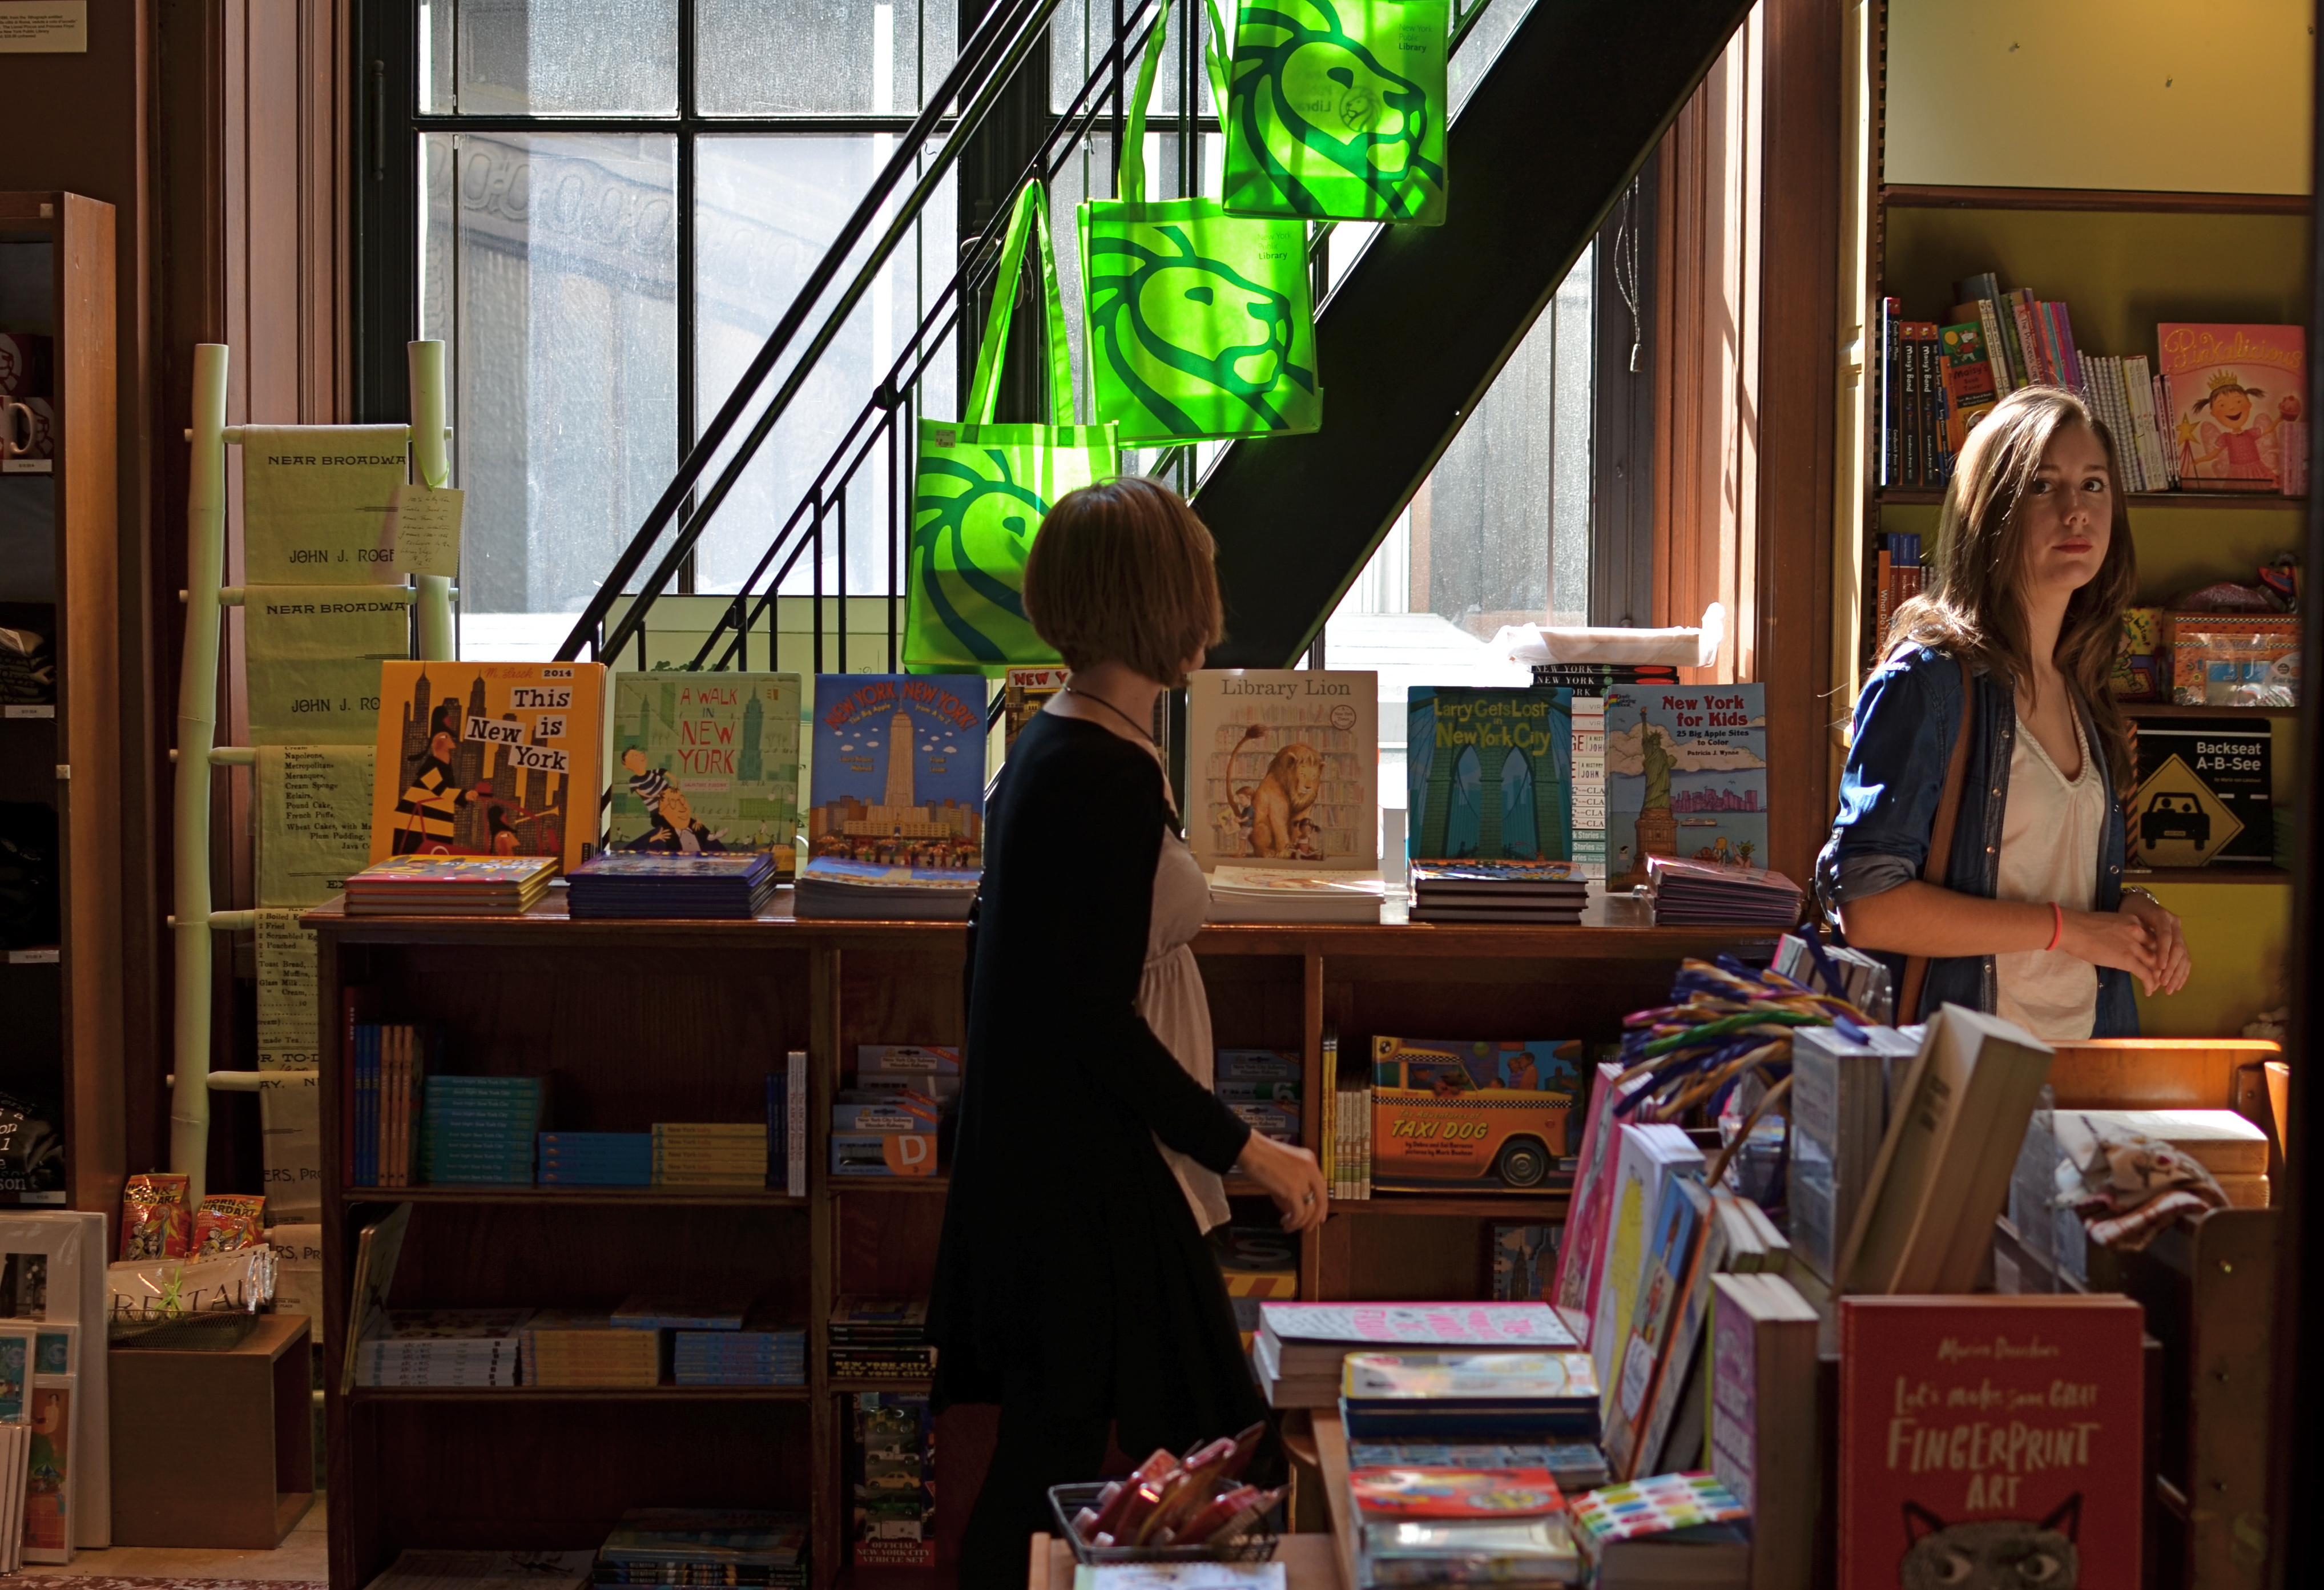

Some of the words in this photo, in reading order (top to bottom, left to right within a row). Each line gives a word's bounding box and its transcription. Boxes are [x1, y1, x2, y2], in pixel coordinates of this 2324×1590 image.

[1399, 43, 1427, 53] Library
[2024, 332, 2036, 363] Princess
[2165, 328, 2302, 369] Pinkalicious
[1905, 345, 1914, 373] Maisy's
[1954, 364, 1988, 379] Maisy's
[268, 456, 316, 465] NEAR
[322, 456, 406, 465] BROADWA
[289, 550, 328, 563] JOHN
[337, 550, 348, 562] J.
[267, 605, 315, 614] NEAR
[321, 602, 409, 614] BROADWA
[1880, 616, 1887, 625] Do
[485, 667, 501, 678] M.
[1536, 665, 1560, 673] NEW
[1564, 665, 1594, 673] YORK
[1014, 671, 1049, 686] NEW
[1537, 676, 1560, 685] NEW
[1565, 676, 1594, 685] YORK
[680, 688, 691, 705] A
[696, 688, 738, 705] WALK
[1222, 679, 1299, 700] Library
[1305, 679, 1351, 695] Lion
[292, 698, 331, 713] JOHN
[340, 698, 351, 711] J.
[514, 689, 570, 707] This
[1662, 695, 1698, 710] New
[1703, 694, 1745, 710] York
[703, 708, 715, 718] IN
[823, 695, 857, 731] NEW
[903, 681, 939, 705] NEW
[936, 689, 980, 732] YORK!
[849, 715, 861, 725] The
[861, 710, 873, 718] Big
[873, 703, 891, 713] Apple
[915, 703, 931, 714] from
[1433, 698, 1473, 722] Larry
[1474, 699, 1511, 718] Gets
[1511, 699, 1549, 718] Lost
[541, 716, 563, 736] is
[1676, 712, 1704, 727] for
[1709, 711, 1749, 727] Kids
[468, 718, 522, 743] New
[682, 720, 735, 746] NEW
[1688, 730, 1702, 739] Big
[1704, 730, 1727, 738] Apple
[1435, 722, 1478, 748] New
[1475, 722, 1514, 749] York
[1513, 722, 1552, 756] City
[2196, 742, 2262, 755] Backseat
[515, 745, 567, 771] York
[678, 749, 735, 774] YORK
[2196, 756, 2261, 771] A-B-See
[285, 762, 335, 771] Metropolitans
[1581, 770, 1600, 779] JOHN
[312, 782, 339, 791] Sponge
[312, 801, 333, 810] Cake,
[315, 811, 336, 820] Puffs,
[314, 823, 338, 831] Cakes,
[332, 832, 365, 842] Pudding,
[1578, 831, 1600, 839] Stories
[1573, 842, 1595, 851] Stories
[1399, 1109, 1415, 1118] The
[1417, 1110, 1468, 1120] Adventures
[1469, 1111, 1482, 1120] of
[1392, 1120, 1440, 1138] TAXI
[1442, 1121, 1489, 1140] DOG
[898, 1134, 927, 1165] D
[202, 1204, 257, 1217] HARDART
[236, 1199, 248, 1209] &
[1947, 1377, 2004, 1412] make
[2005, 1388, 2044, 1412] some
[1887, 1416, 2102, 1474] FINGERPRINT
[1965, 1473, 2022, 1511] ART
